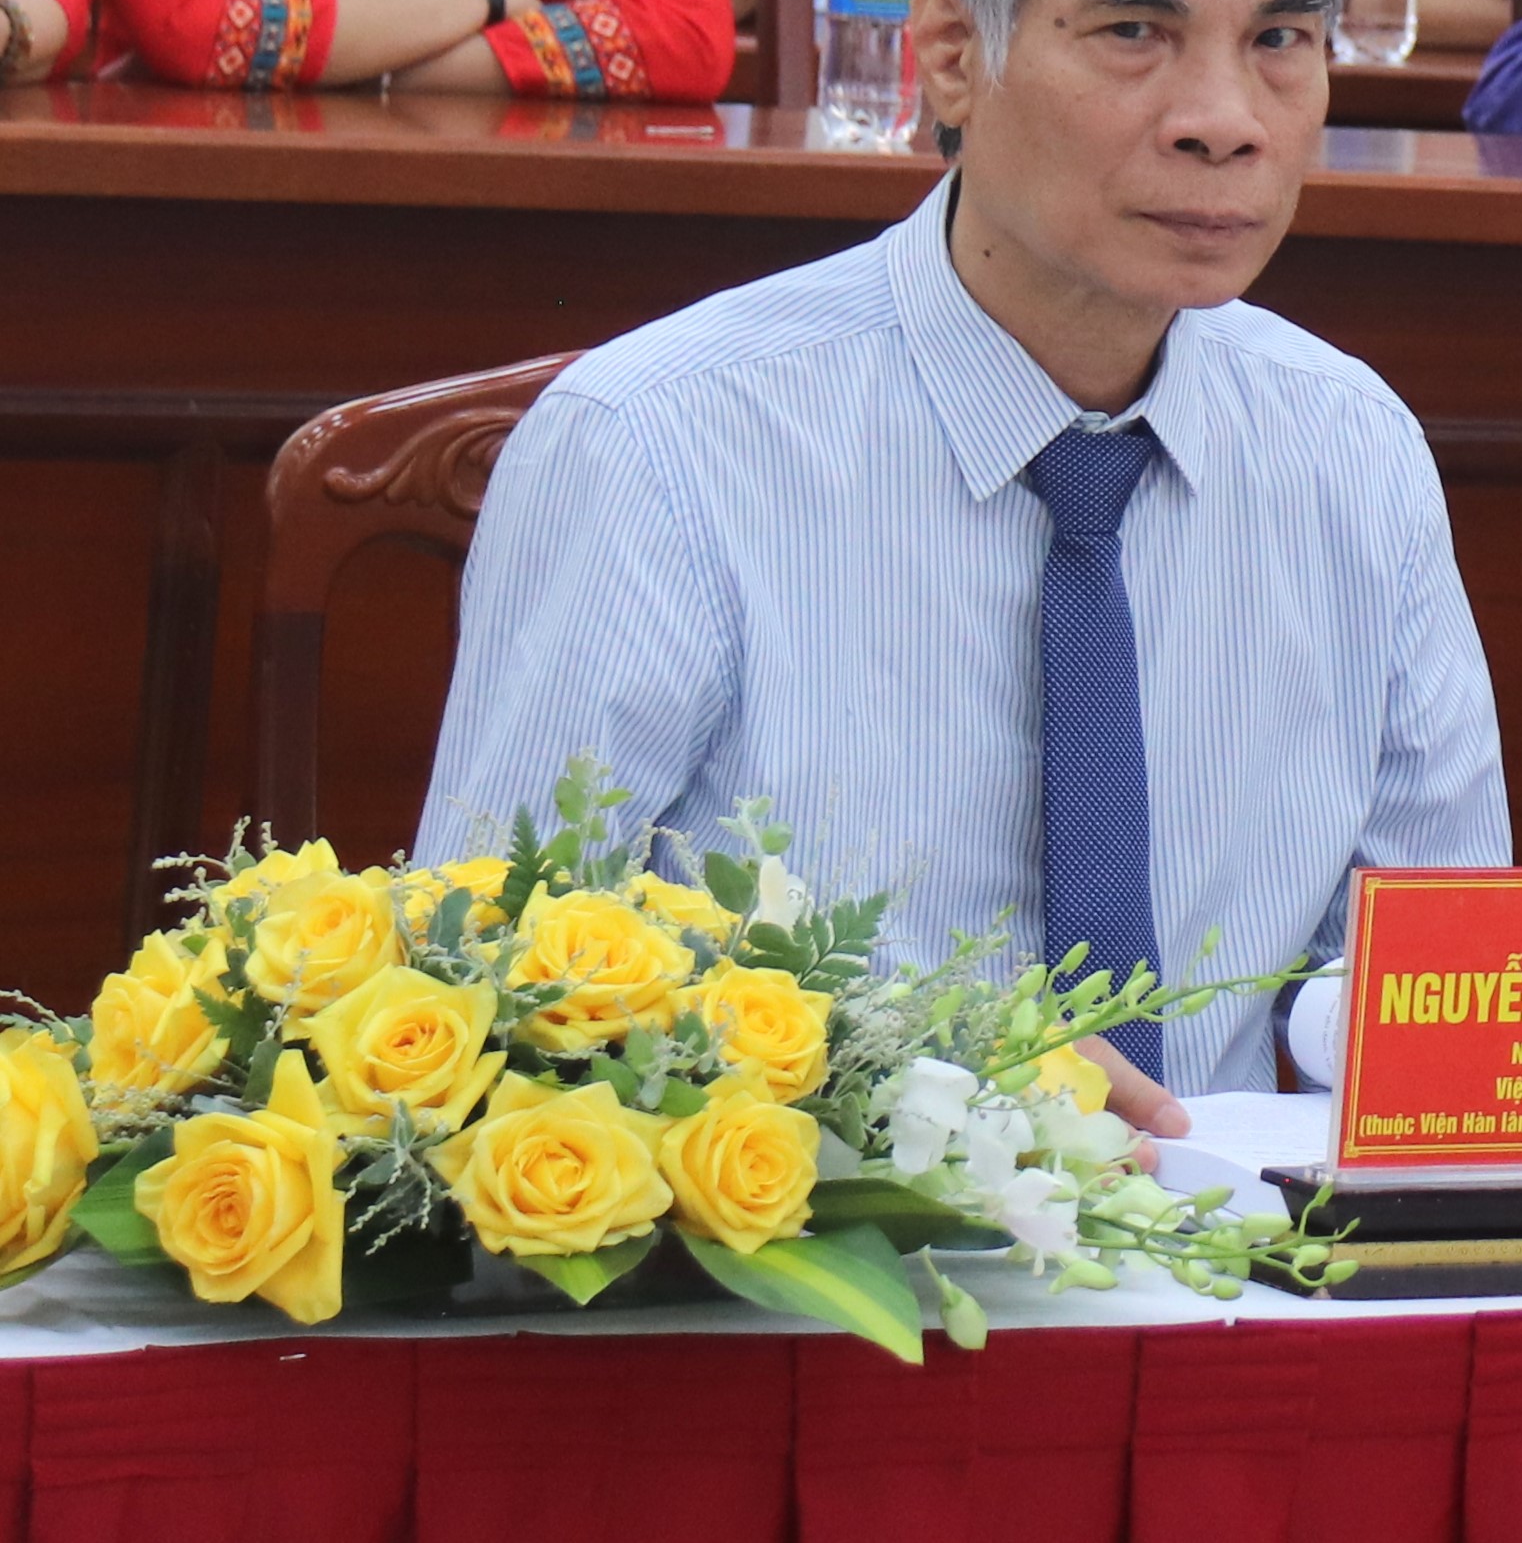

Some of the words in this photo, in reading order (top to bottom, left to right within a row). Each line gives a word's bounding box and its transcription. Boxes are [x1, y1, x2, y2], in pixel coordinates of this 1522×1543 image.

[1359, 1114, 1415, 1138] (thuộc
[1420, 1113, 1457, 1137] Viện
[1462, 1113, 1496, 1133] Hàn
